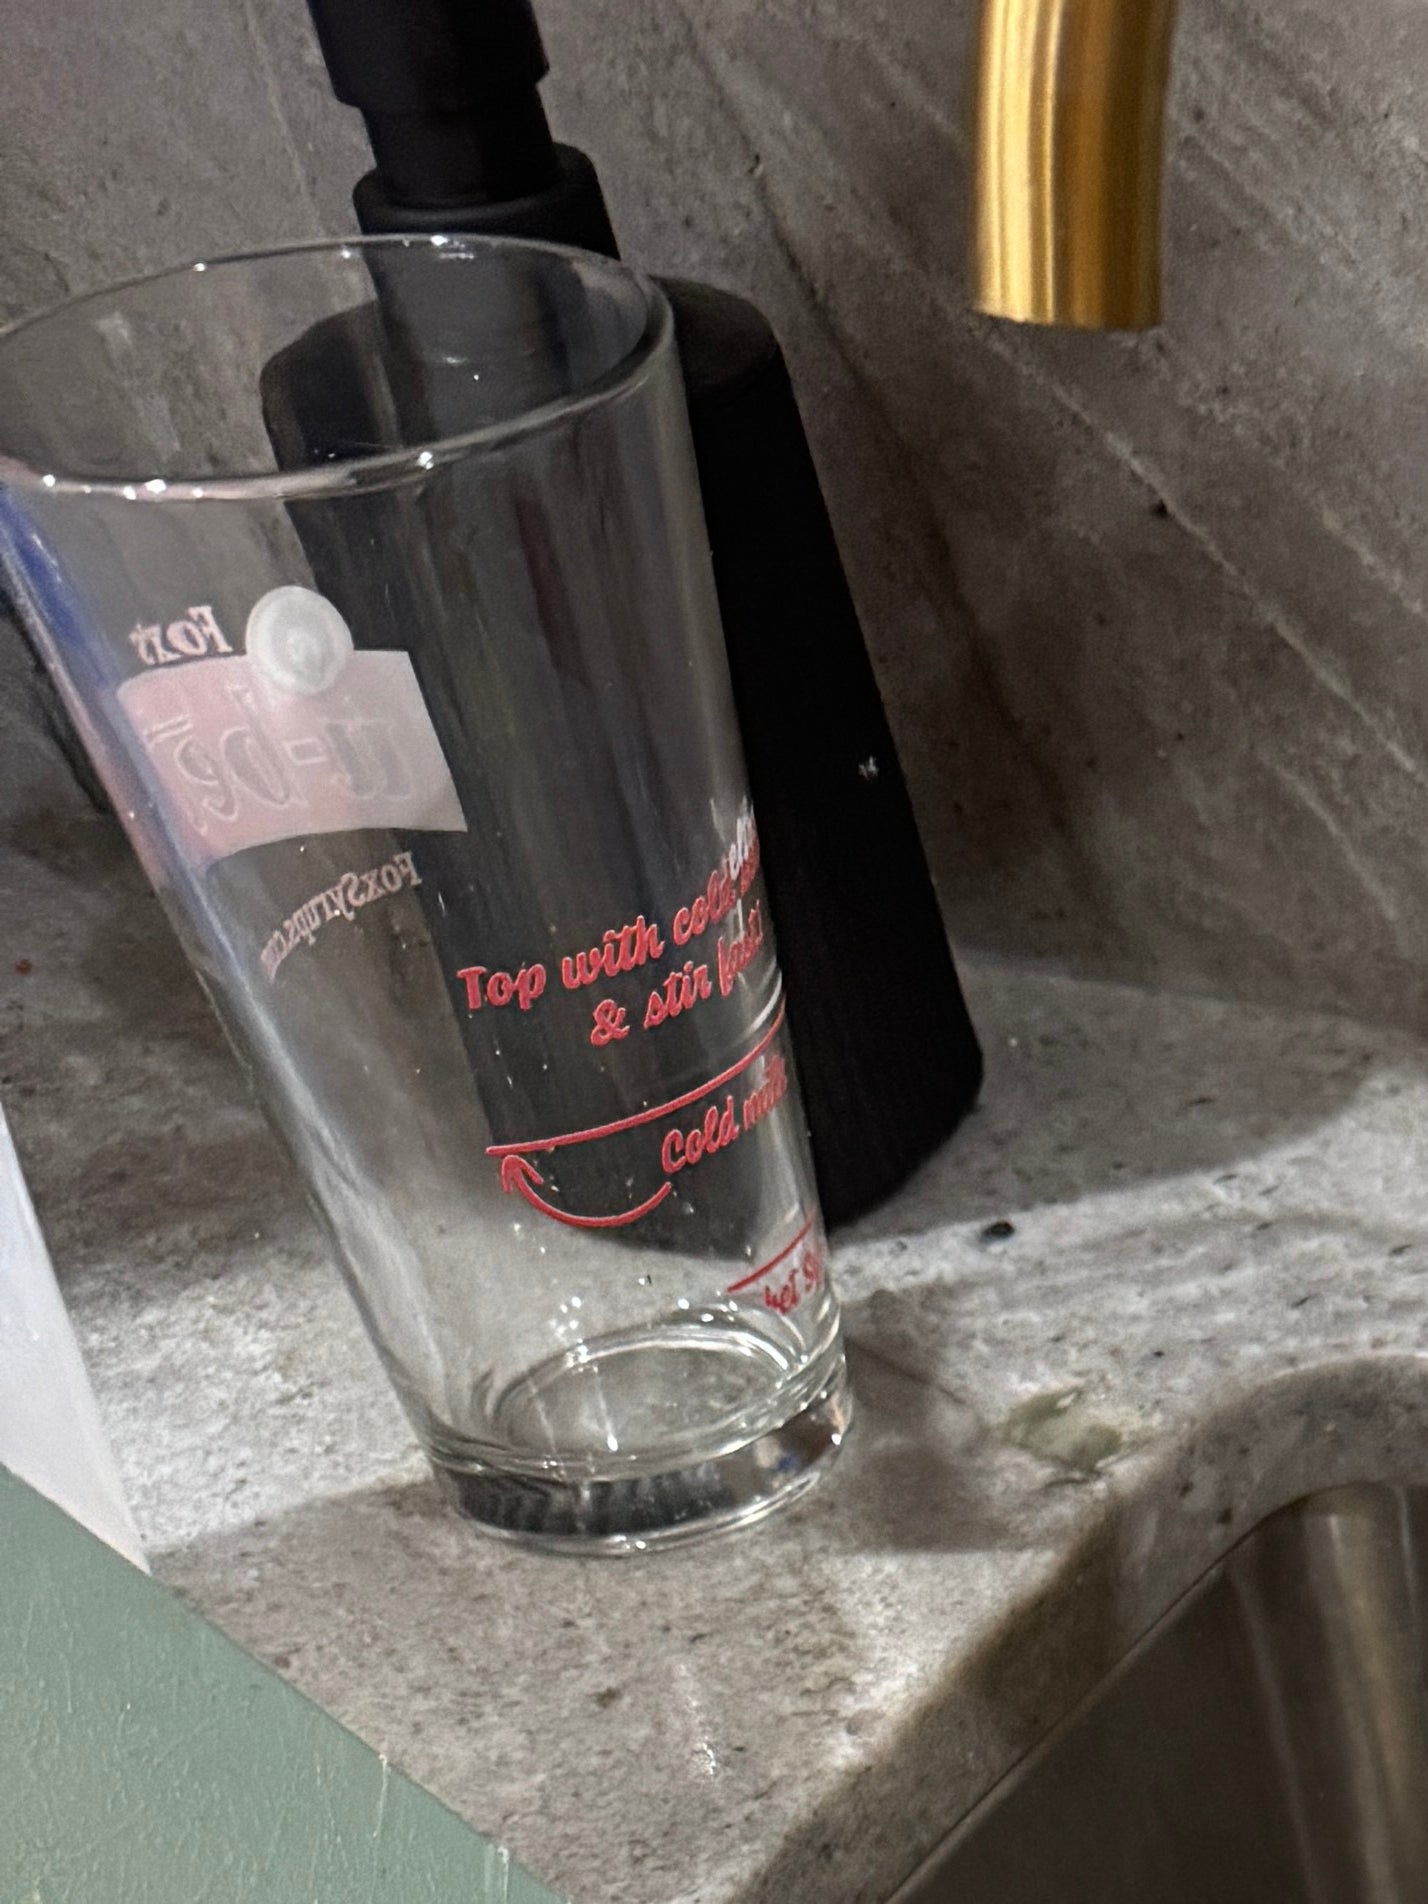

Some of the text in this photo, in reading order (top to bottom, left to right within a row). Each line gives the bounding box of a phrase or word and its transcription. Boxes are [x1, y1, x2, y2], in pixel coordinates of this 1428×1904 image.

[456, 965, 547, 1011] Top
[561, 914, 665, 989] with
[589, 999, 631, 1047] &
[643, 960, 713, 1029] stir
[661, 1095, 739, 1174] Cold
